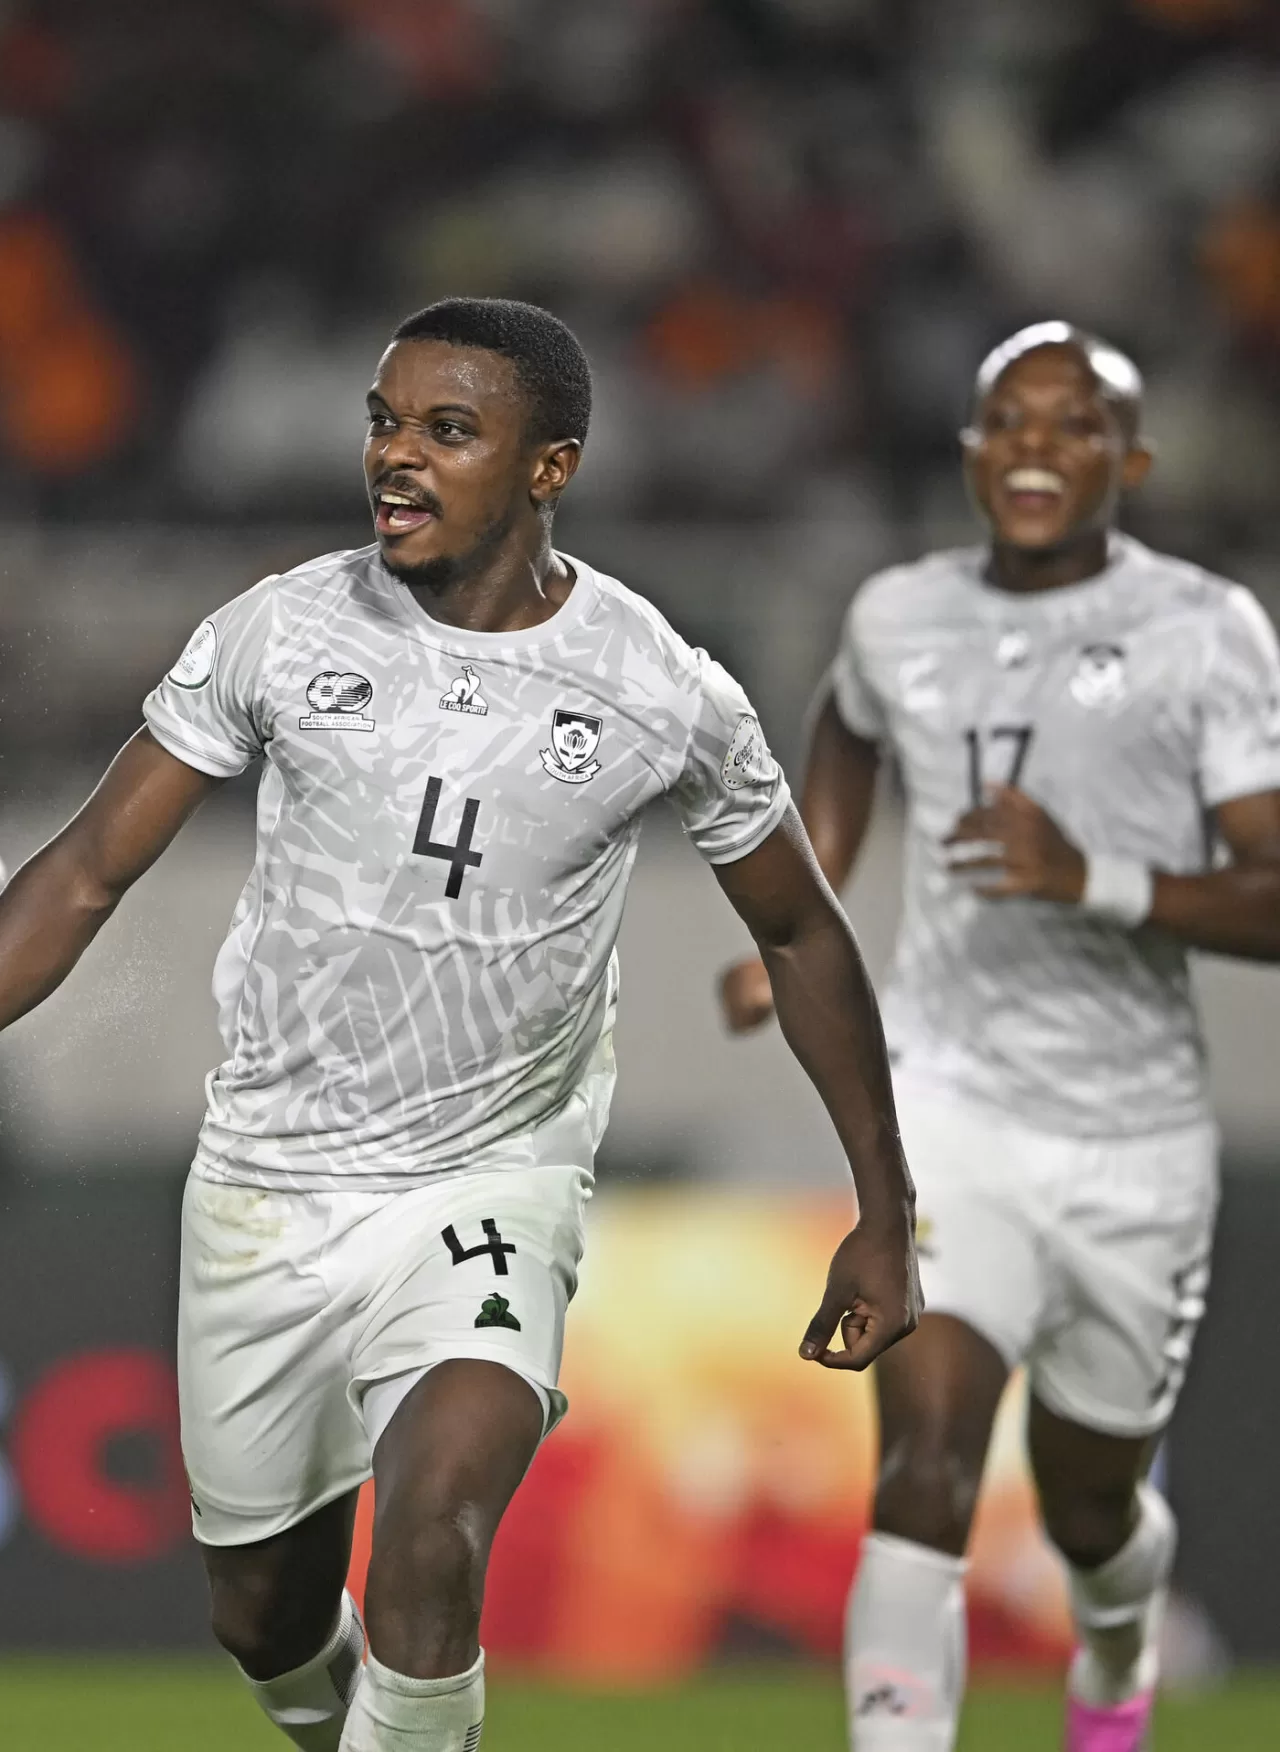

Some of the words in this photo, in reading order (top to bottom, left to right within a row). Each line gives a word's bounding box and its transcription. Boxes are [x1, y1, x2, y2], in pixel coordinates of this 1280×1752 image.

[440, 700, 448, 709] LE
[448, 702, 462, 711] COQ
[963, 725, 1034, 807] 17
[412, 776, 483, 899] 4
[440, 1218, 517, 1275] 4
